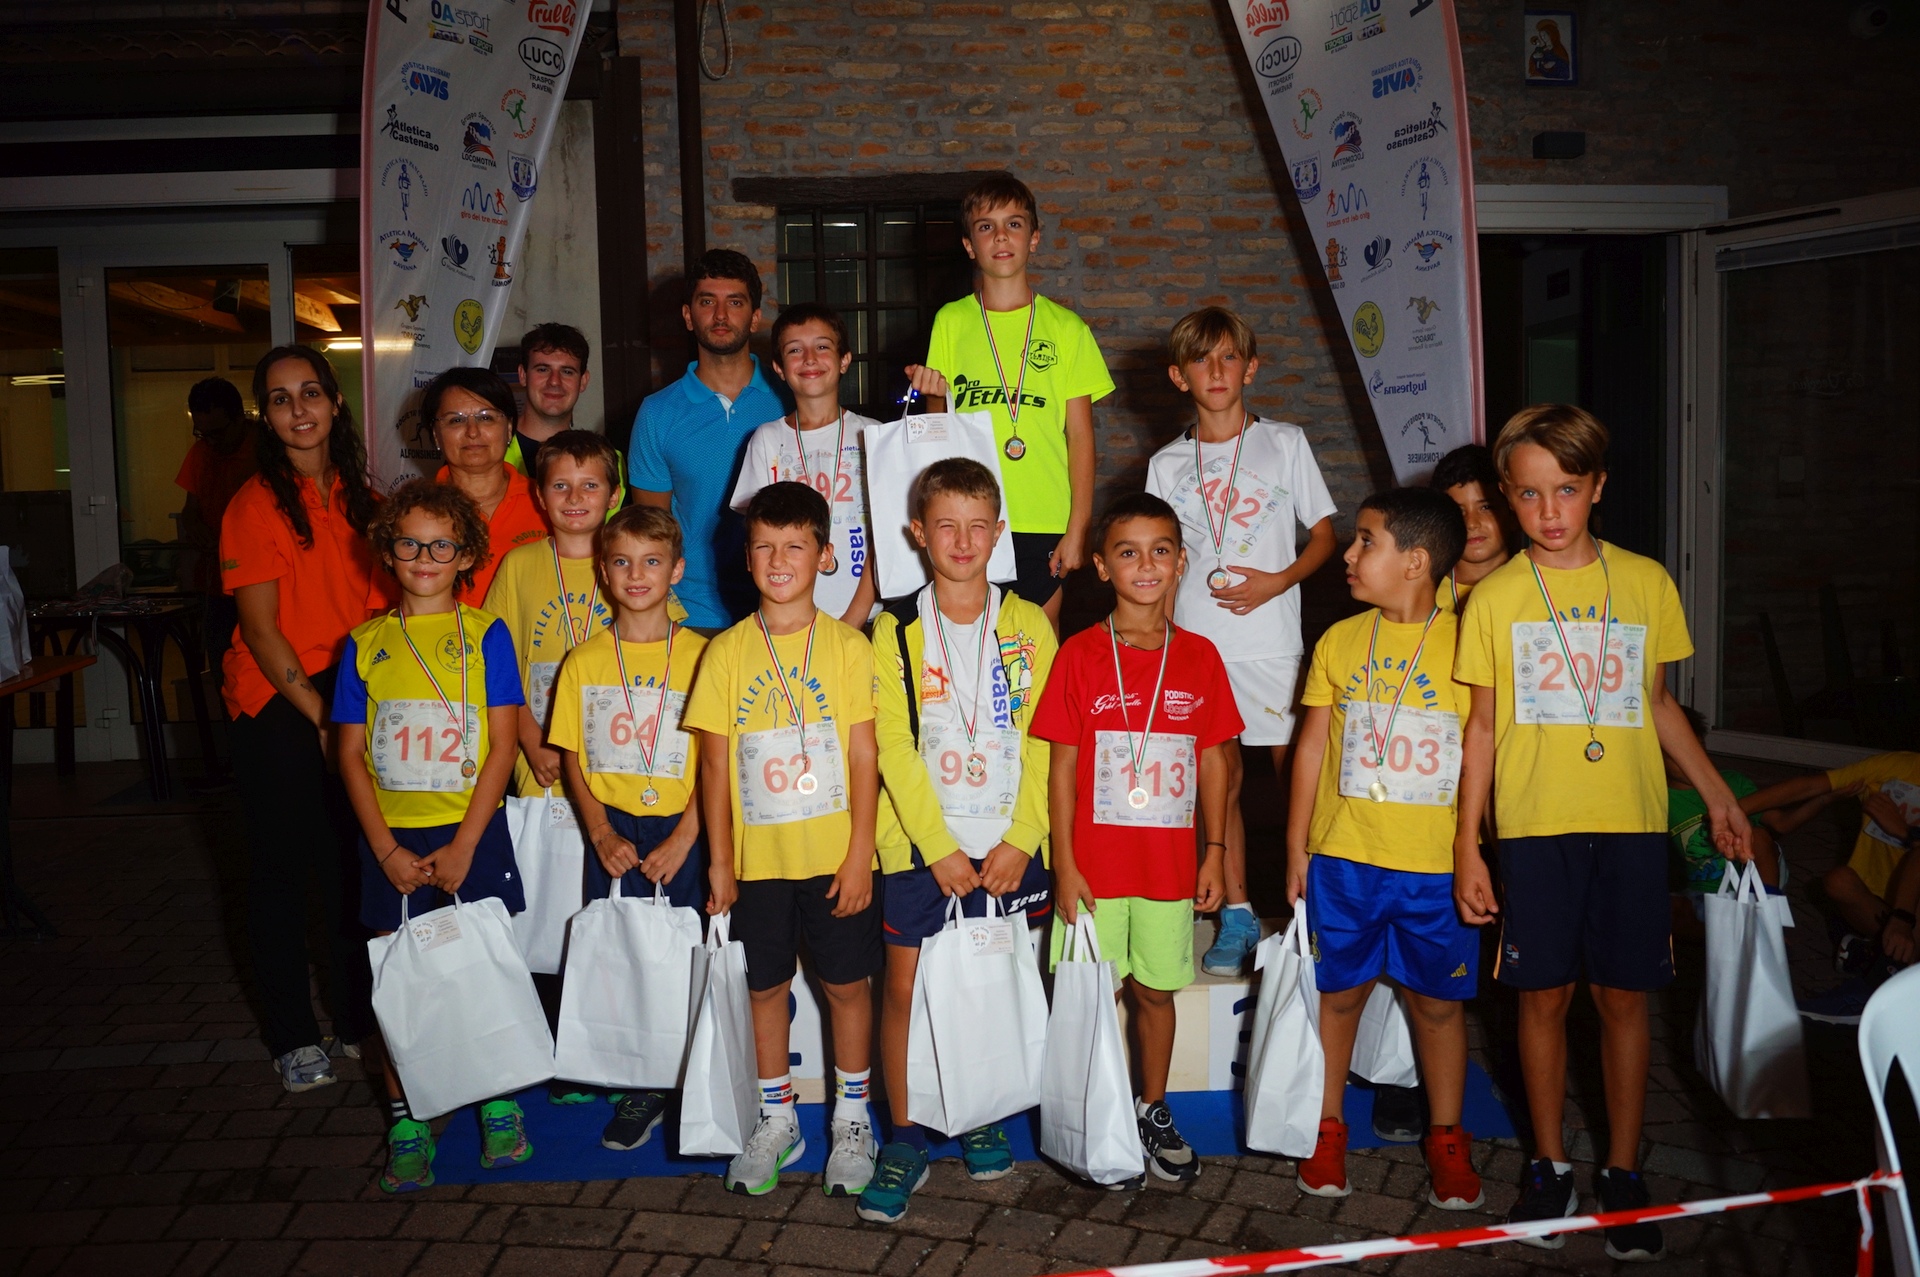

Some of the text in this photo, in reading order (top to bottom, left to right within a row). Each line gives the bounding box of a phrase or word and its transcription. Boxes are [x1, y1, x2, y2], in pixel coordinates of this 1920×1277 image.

[410, 71, 450, 100] AVIS
[392, 130, 440, 152] Castenaso
[394, 120, 431, 139] Atletica
[461, 152, 497, 168] LOCOMOTIVA
[969, 388, 1047, 409] Ethics
[1195, 477, 1261, 529] 492
[371, 654, 391, 666] adidas
[1538, 652, 1624, 693] 209
[737, 666, 798, 726] ATLETIA
[394, 726, 462, 763] 112
[609, 711, 656, 748] 64
[1359, 733, 1441, 776] 303
[763, 753, 812, 794] 62
[1121, 760, 1185, 798] 113
